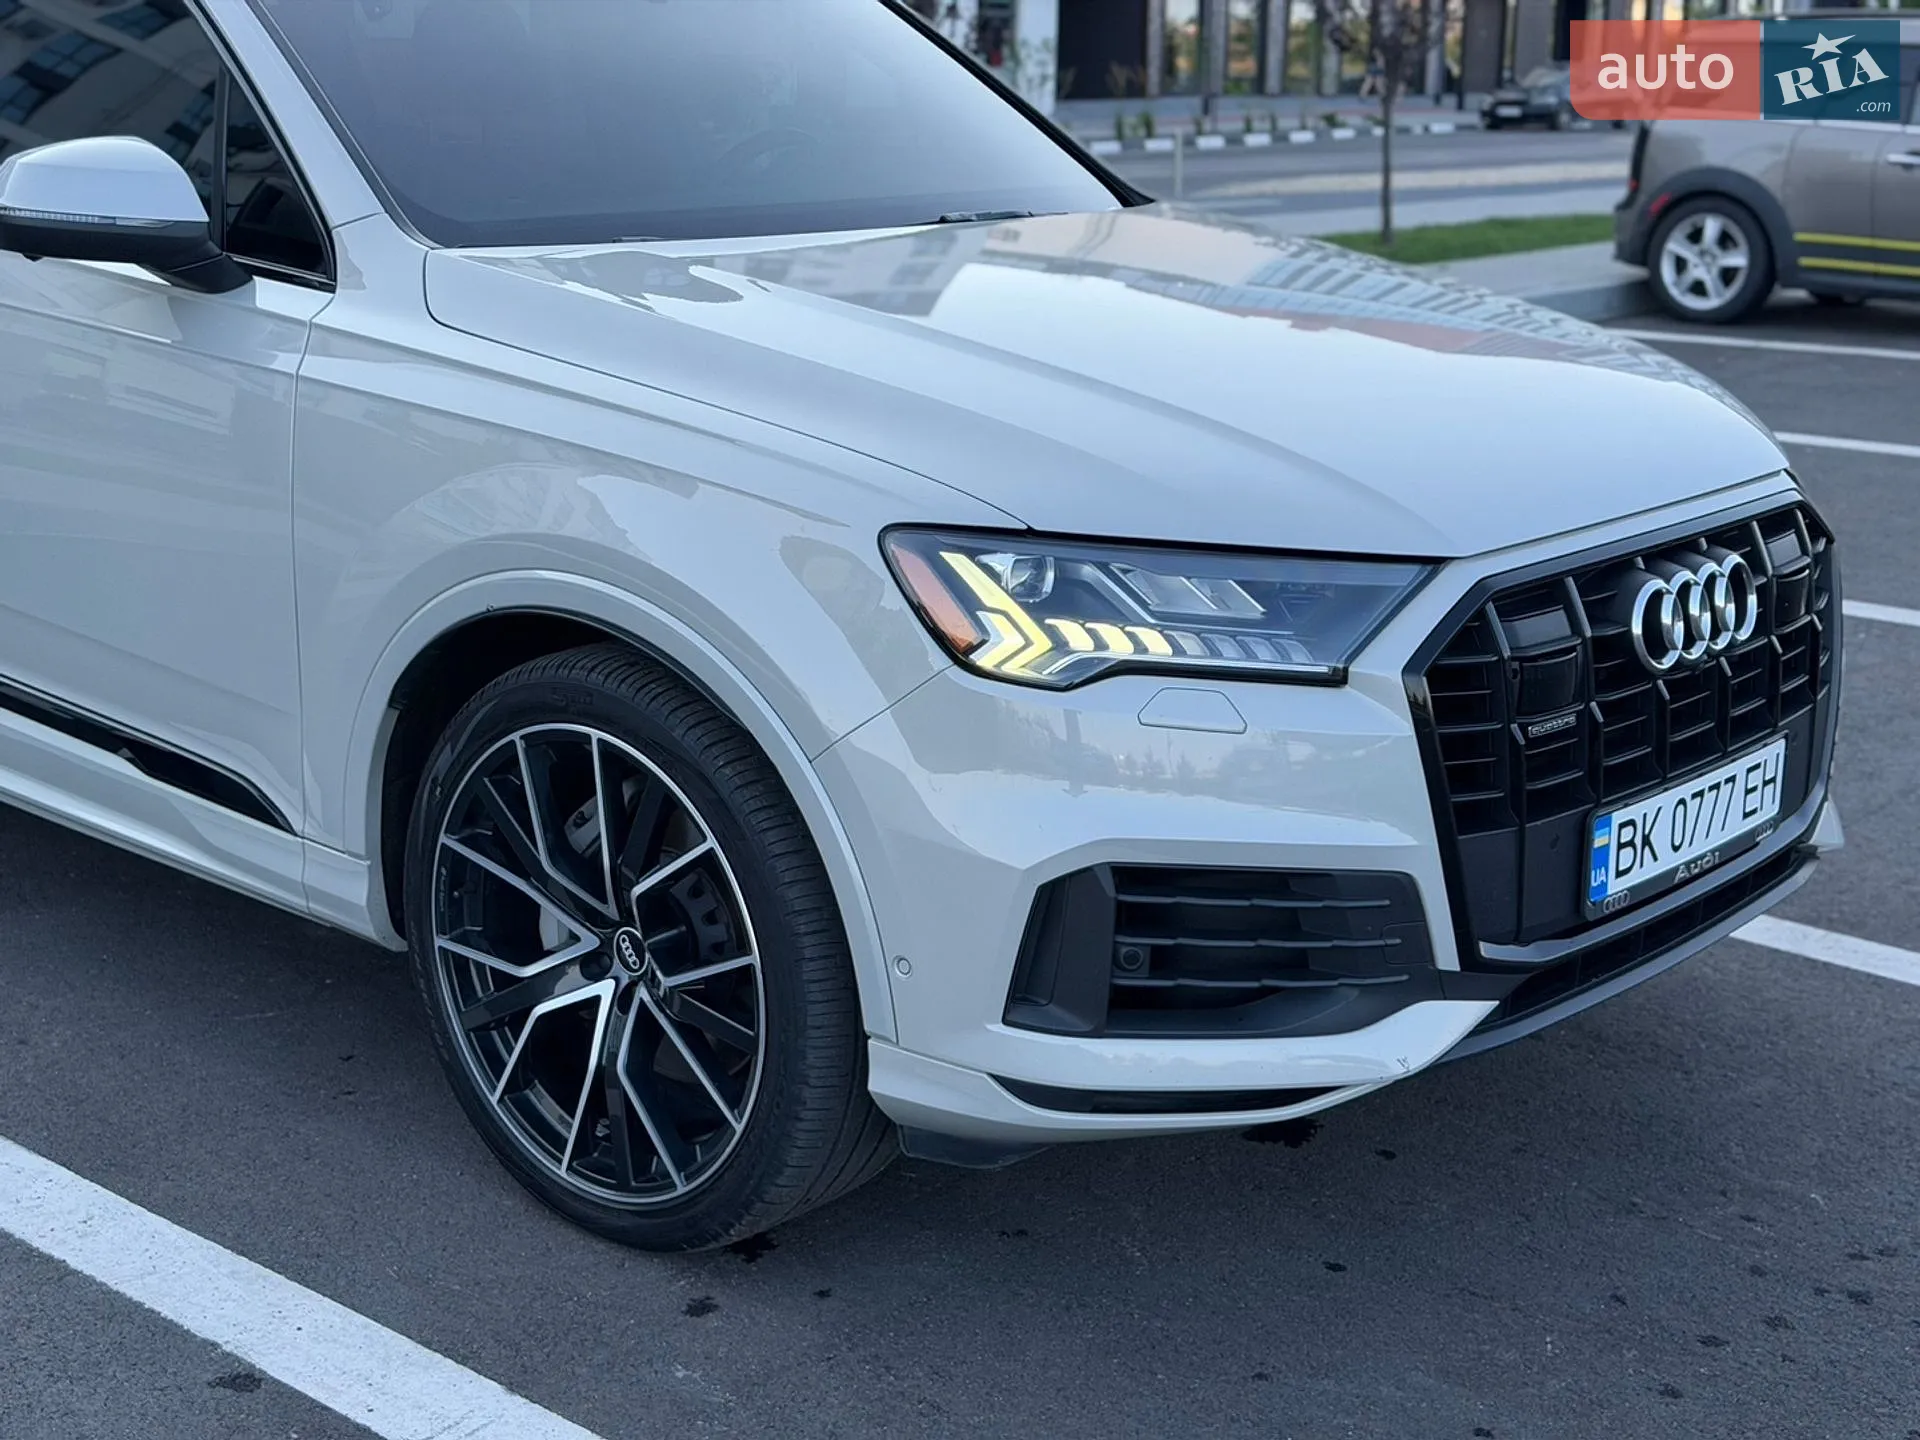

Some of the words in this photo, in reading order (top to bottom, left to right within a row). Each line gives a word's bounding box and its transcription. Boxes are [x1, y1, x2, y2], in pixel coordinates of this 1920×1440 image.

[1614, 805, 1663, 880] BK
[1670, 774, 1737, 853] 0777
[1742, 752, 1780, 821] EH
[1591, 869, 1607, 886] UA
